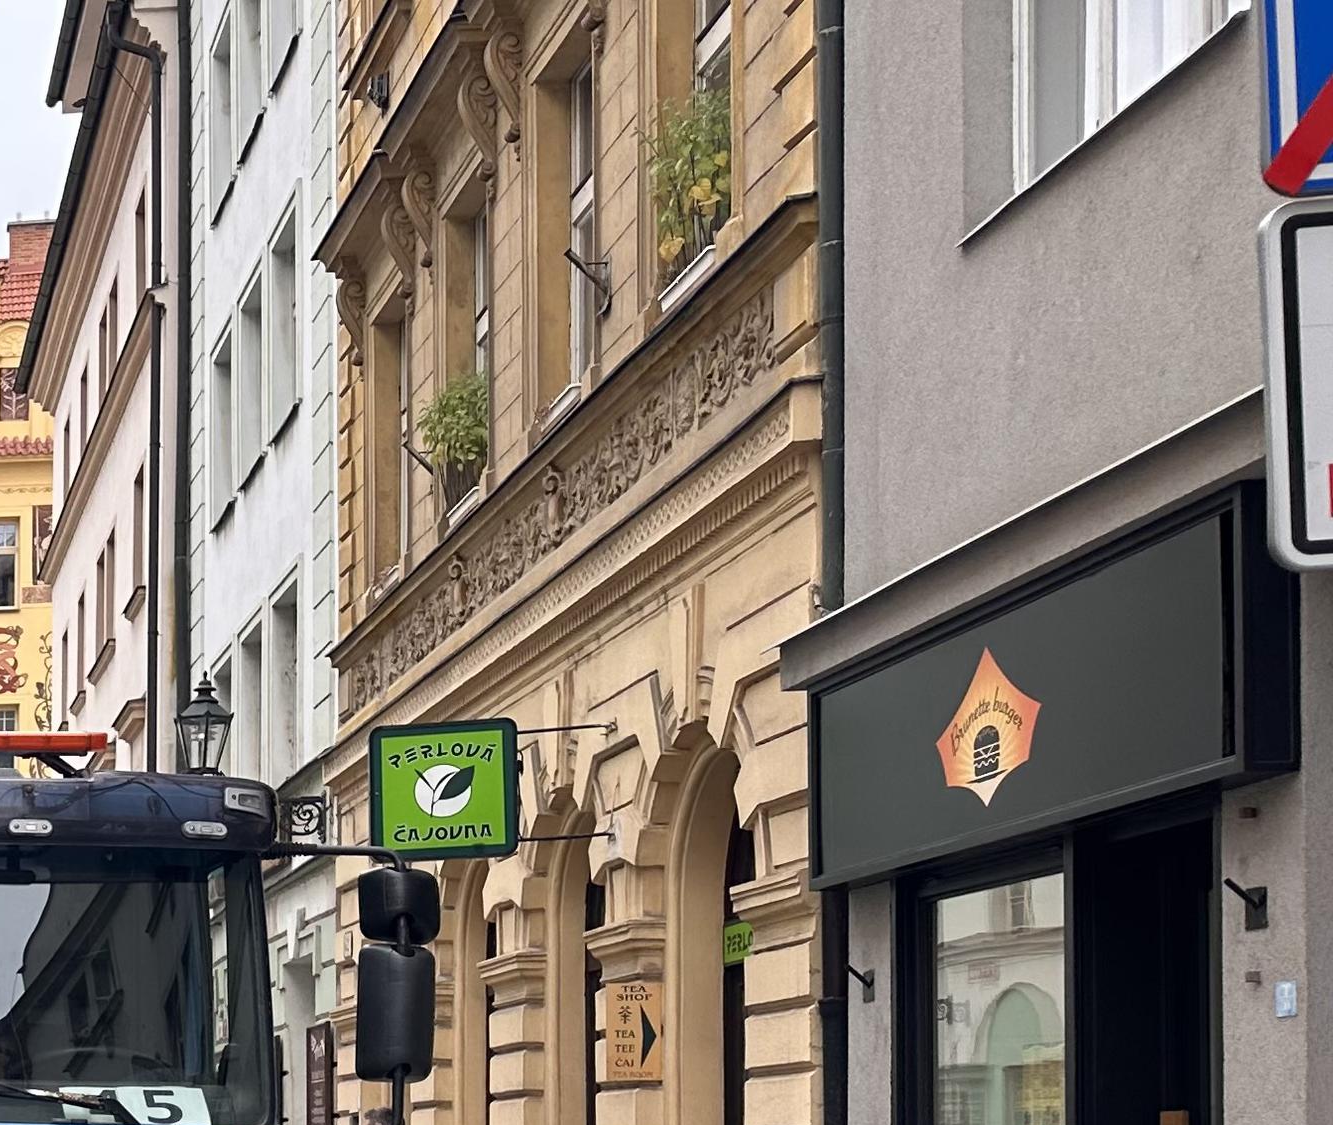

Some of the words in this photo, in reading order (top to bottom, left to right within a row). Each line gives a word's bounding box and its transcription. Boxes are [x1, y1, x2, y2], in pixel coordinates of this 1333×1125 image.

[993, 686, 1023, 731] burger
[615, 1030, 635, 1038] TEA
[615, 1044, 635, 1053] TEE
